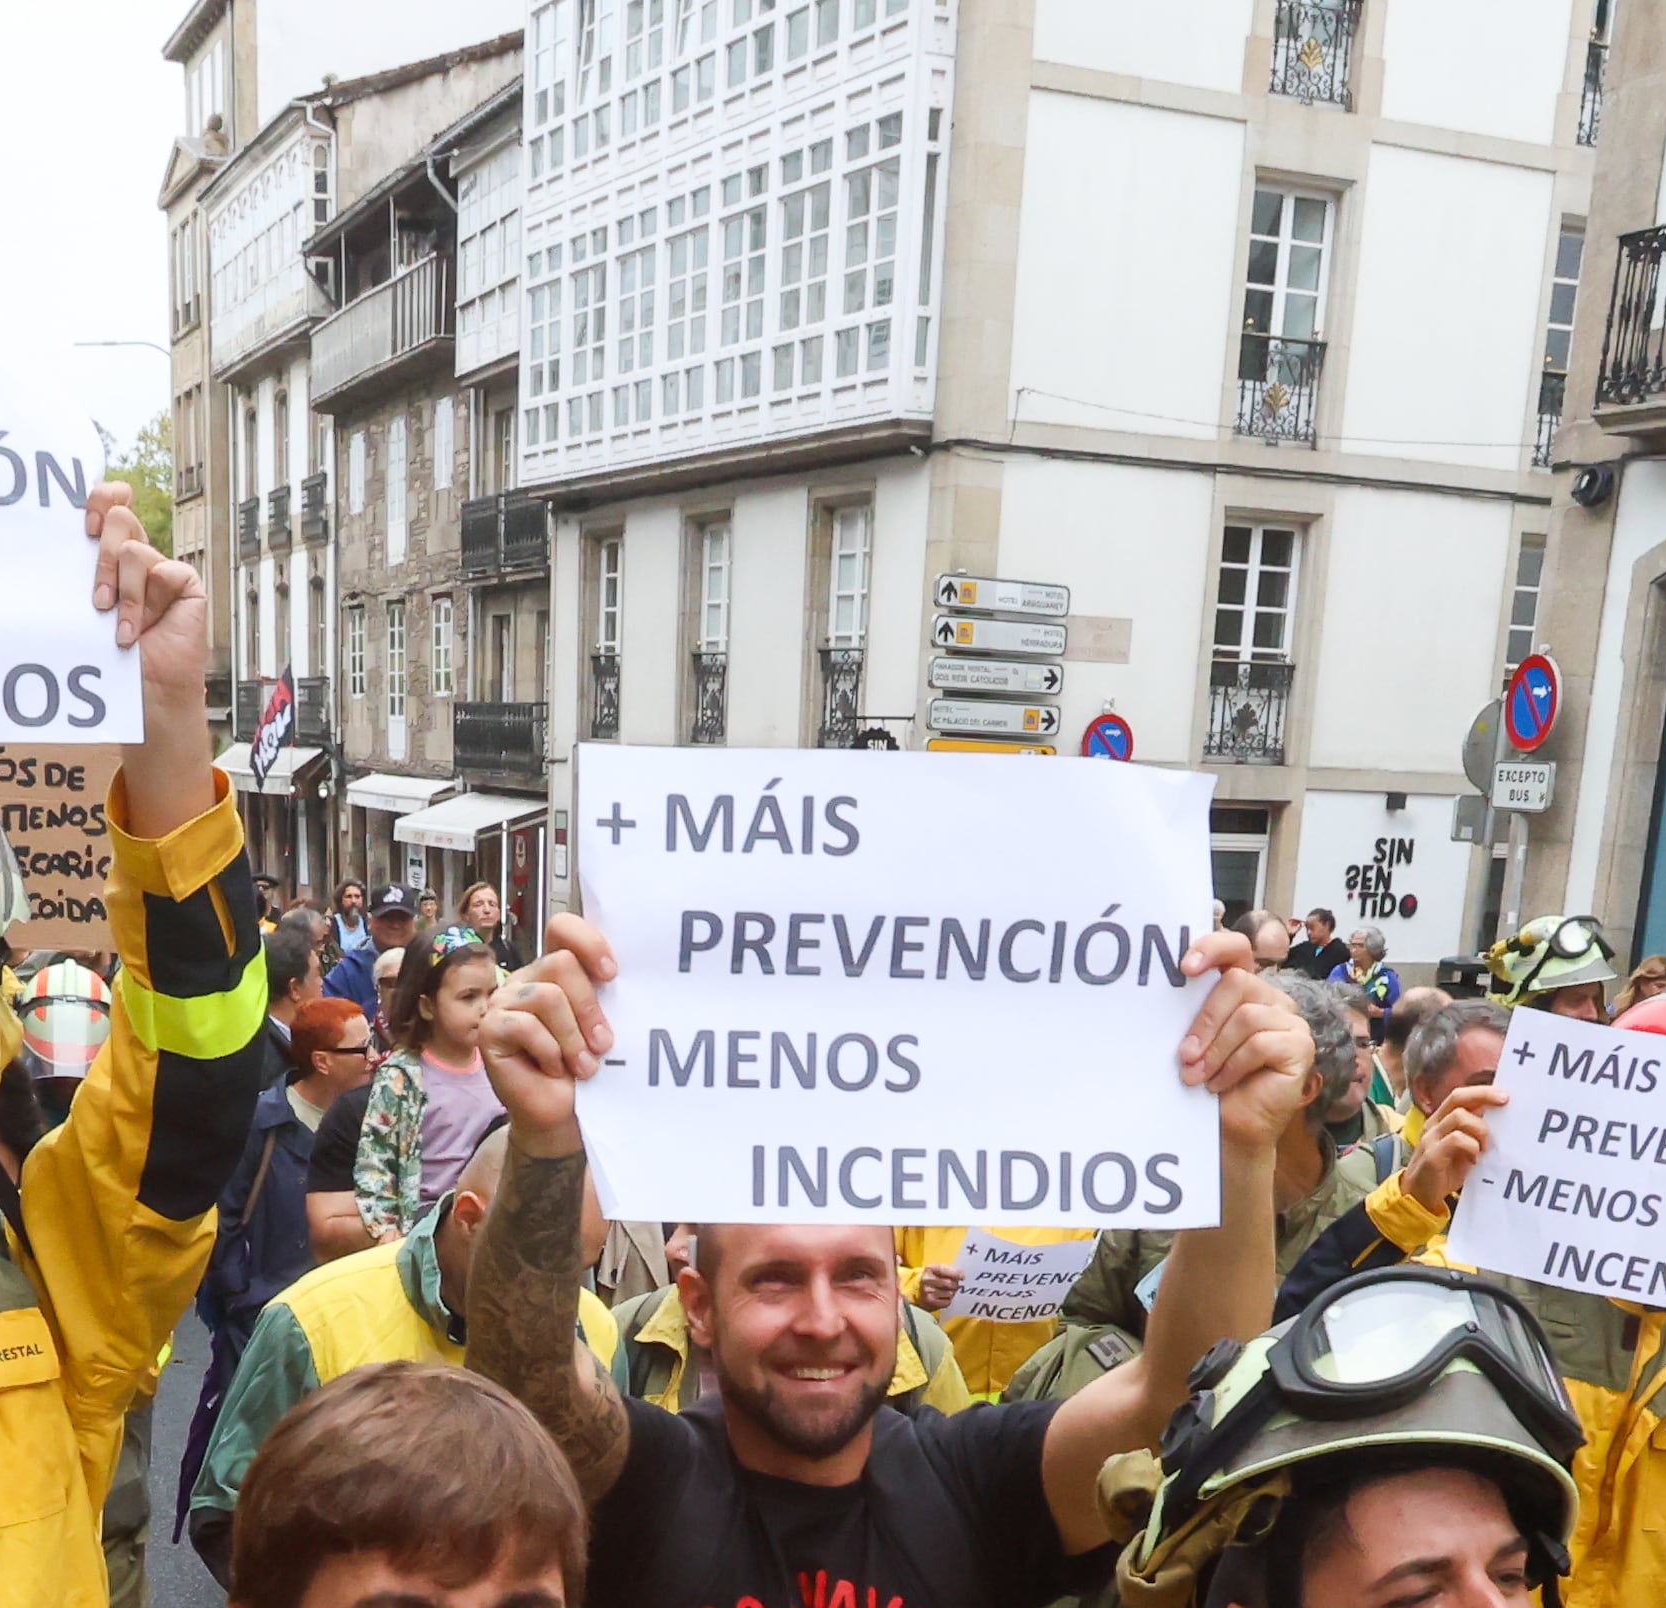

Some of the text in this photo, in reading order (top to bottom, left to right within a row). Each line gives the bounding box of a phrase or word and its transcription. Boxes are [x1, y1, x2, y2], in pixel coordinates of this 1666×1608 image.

[45, 762, 85, 791] DE
[1498, 769, 1546, 784] EXCEPTO
[1509, 789, 1530, 802] BUS
[665, 778, 861, 856] MÁIS
[1373, 837, 1415, 869] SIN
[1358, 891, 1418, 919] TIDO
[678, 904, 1190, 988] PREVENCIÓN
[648, 1028, 922, 1092] MENOS
[1548, 1043, 1662, 1093] MÁIS
[751, 1145, 1184, 1214] INCENDIOS
[1503, 1168, 1663, 1227] MENOS
[984, 1248, 1044, 1265] MÁIS
